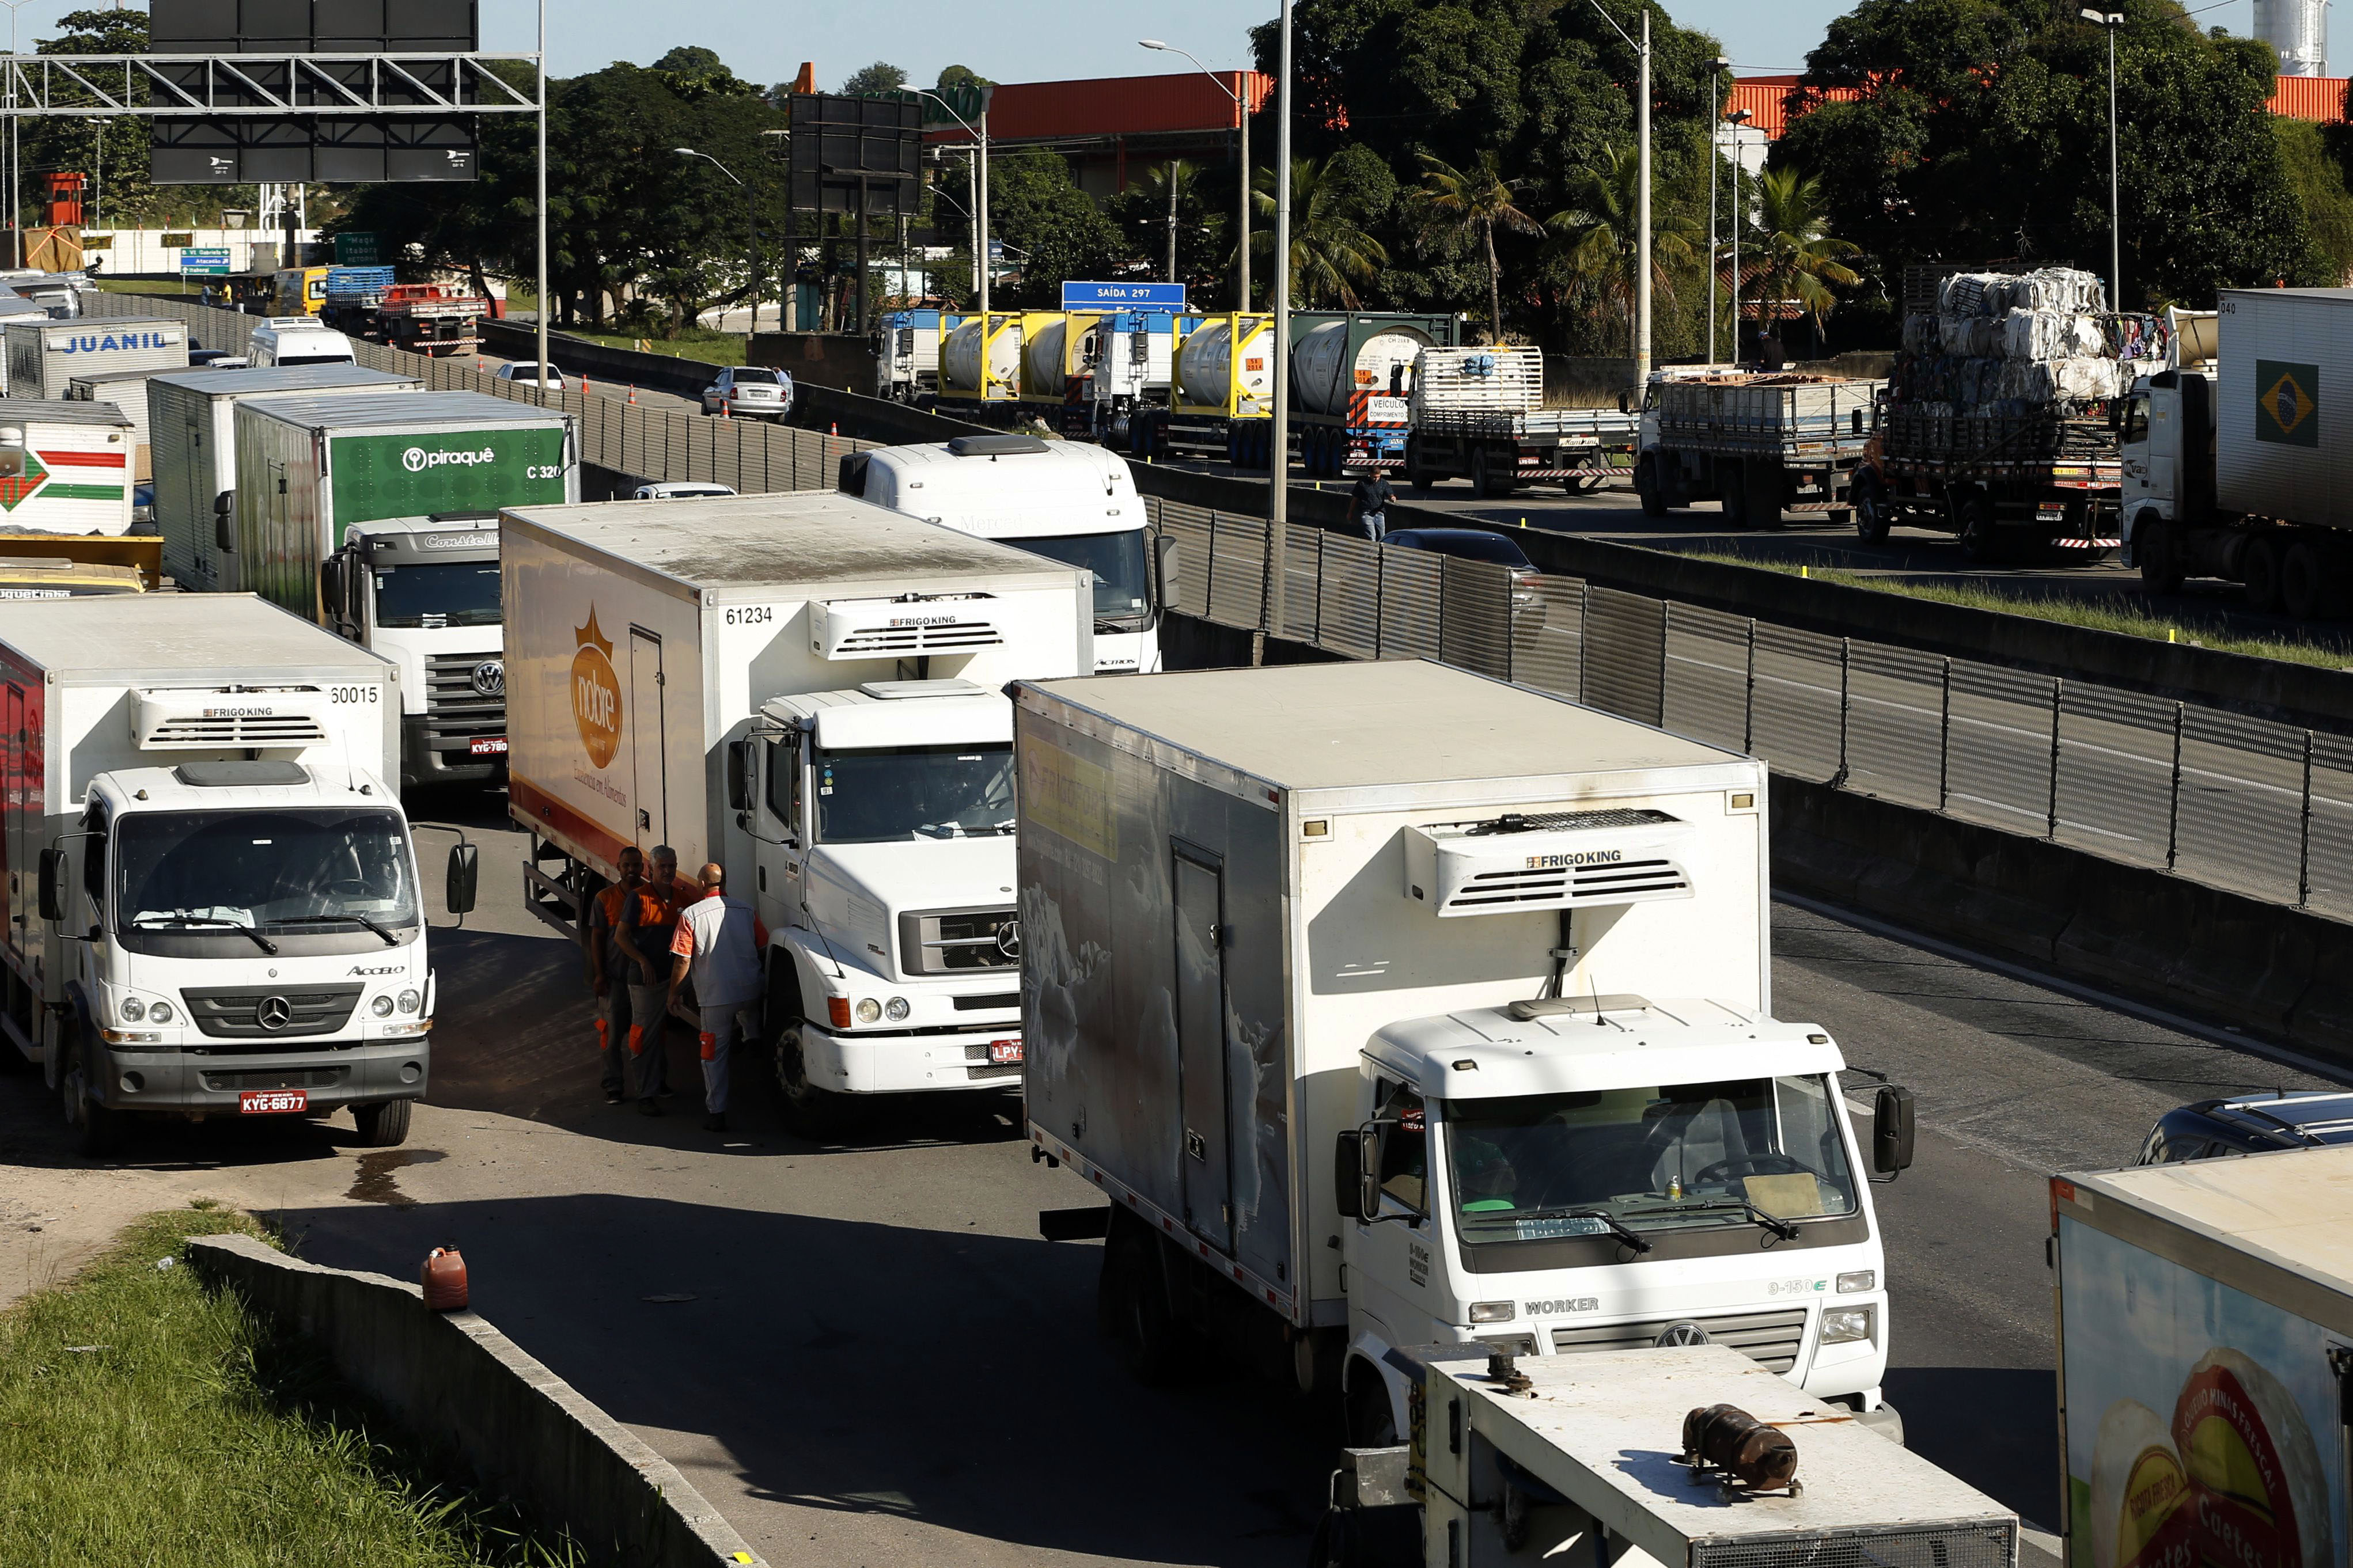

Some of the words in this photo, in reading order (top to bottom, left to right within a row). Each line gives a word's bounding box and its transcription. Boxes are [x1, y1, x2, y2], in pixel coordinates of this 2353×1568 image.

[1097, 286, 1126, 297] SAÍDA
[1132, 289, 1150, 298] 297
[2221, 302, 2235, 314] 040
[63, 332, 166, 354] JUANIL
[1374, 398, 1404, 408] VEÍCULO
[428, 447, 495, 468] piraquê
[526, 465, 536, 479] C
[540, 465, 561, 479] 320
[726, 607, 772, 625] 61234
[899, 618, 930, 627] FRIGO
[931, 616, 956, 625] KING
[331, 687, 378, 703] 60015
[578, 669, 615, 733] nobre
[213, 708, 245, 717] FRIGO
[247, 707, 272, 716] KING
[472, 742, 507, 753] KYG-780
[1541, 853, 1585, 867] FRIGO
[1586, 849, 1621, 864] KING
[1525, 1297, 1599, 1315] WORKER
[2184, 1387, 2208, 1428] QUEIJO
[2210, 1387, 2238, 1419] MINAS
[2238, 1415, 2275, 1495] FRESCAL
[2151, 1472, 2176, 1510] FRESCA
